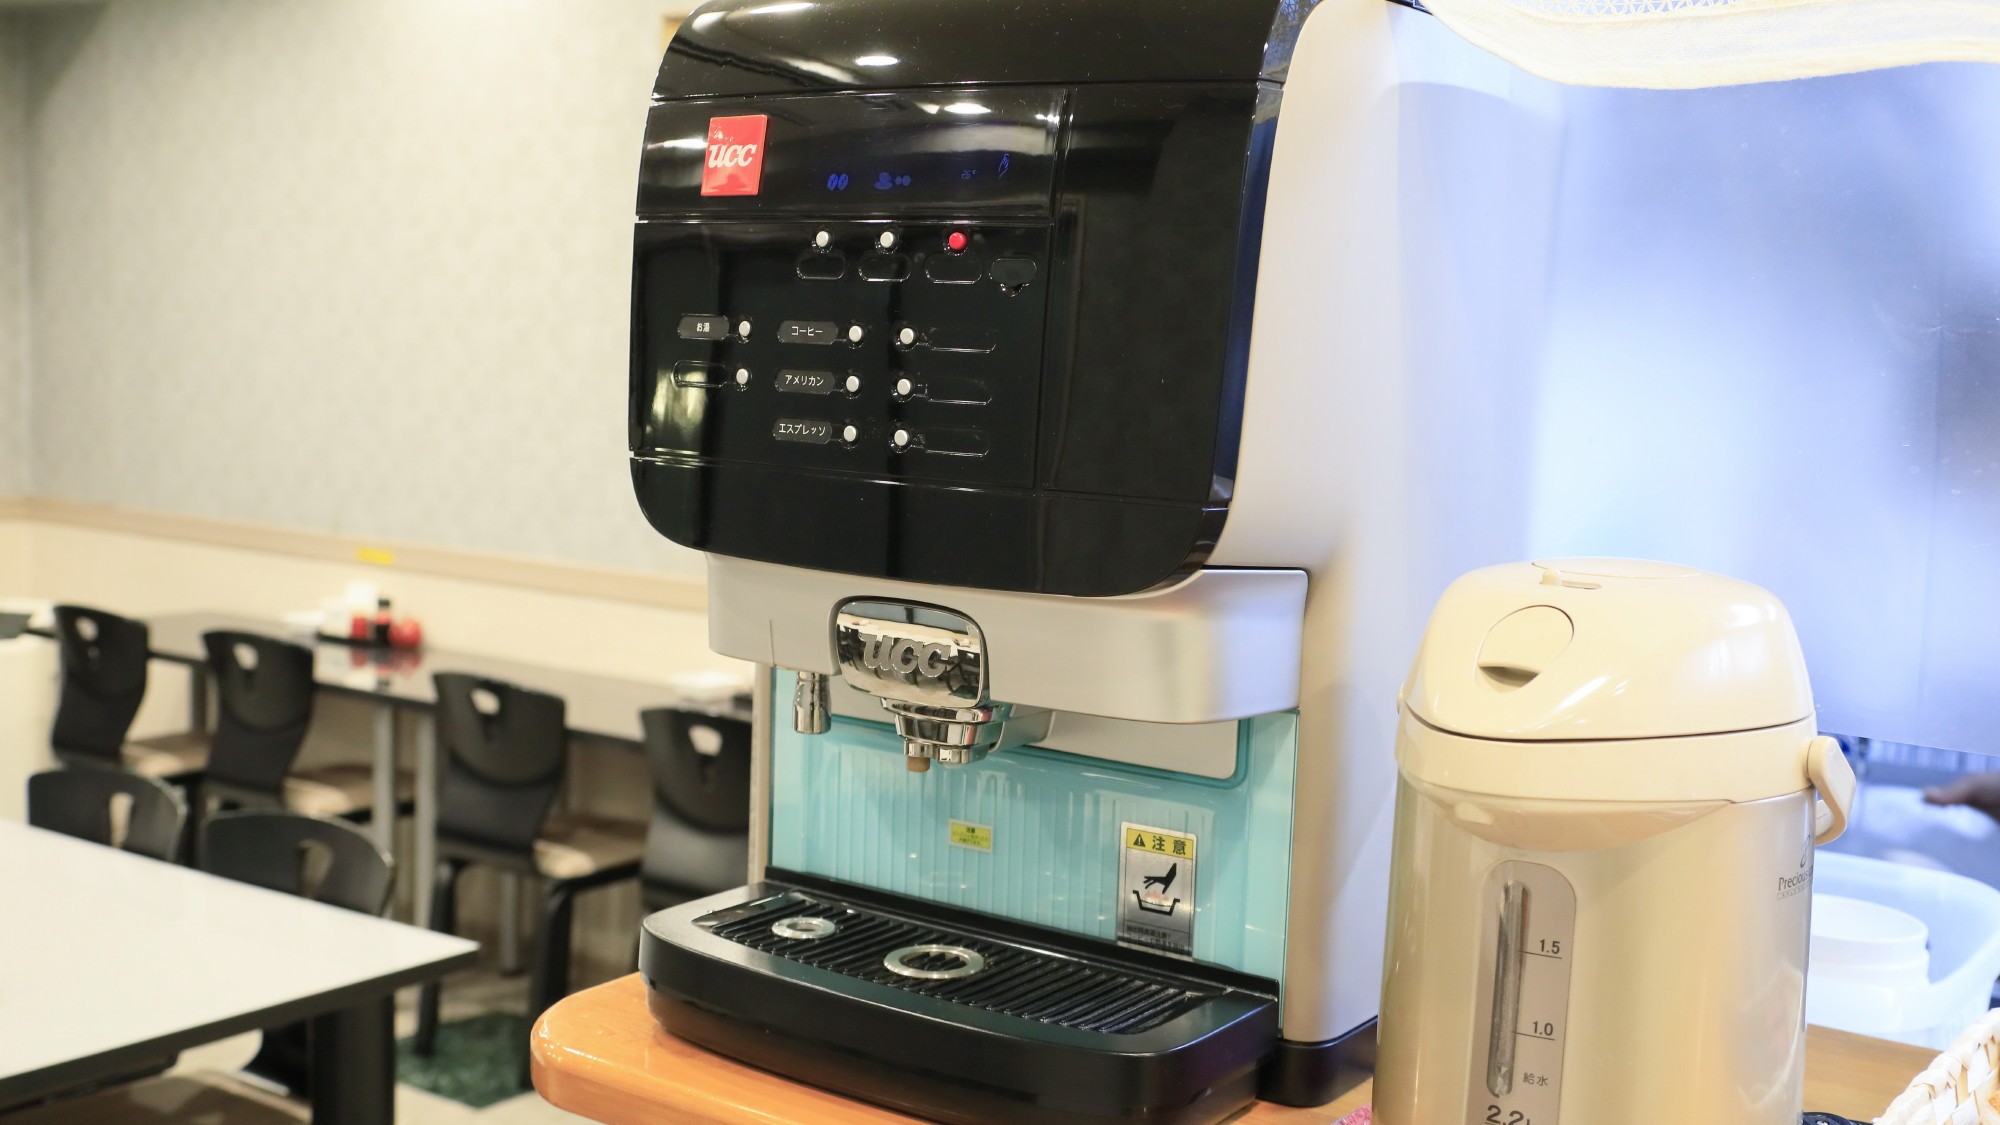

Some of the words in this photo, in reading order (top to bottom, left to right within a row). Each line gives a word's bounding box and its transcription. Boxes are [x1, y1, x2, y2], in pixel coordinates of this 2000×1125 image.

[791, 326, 824, 337] コーヒー
[785, 374, 825, 387] アメリカン
[778, 423, 827, 437] エスプレッソ
[1151, 835, 1187, 856] 注意
[1539, 938, 1561, 955] 1.5
[1532, 1020, 1554, 1037] 1.0
[1522, 1071, 1549, 1087] 給水
